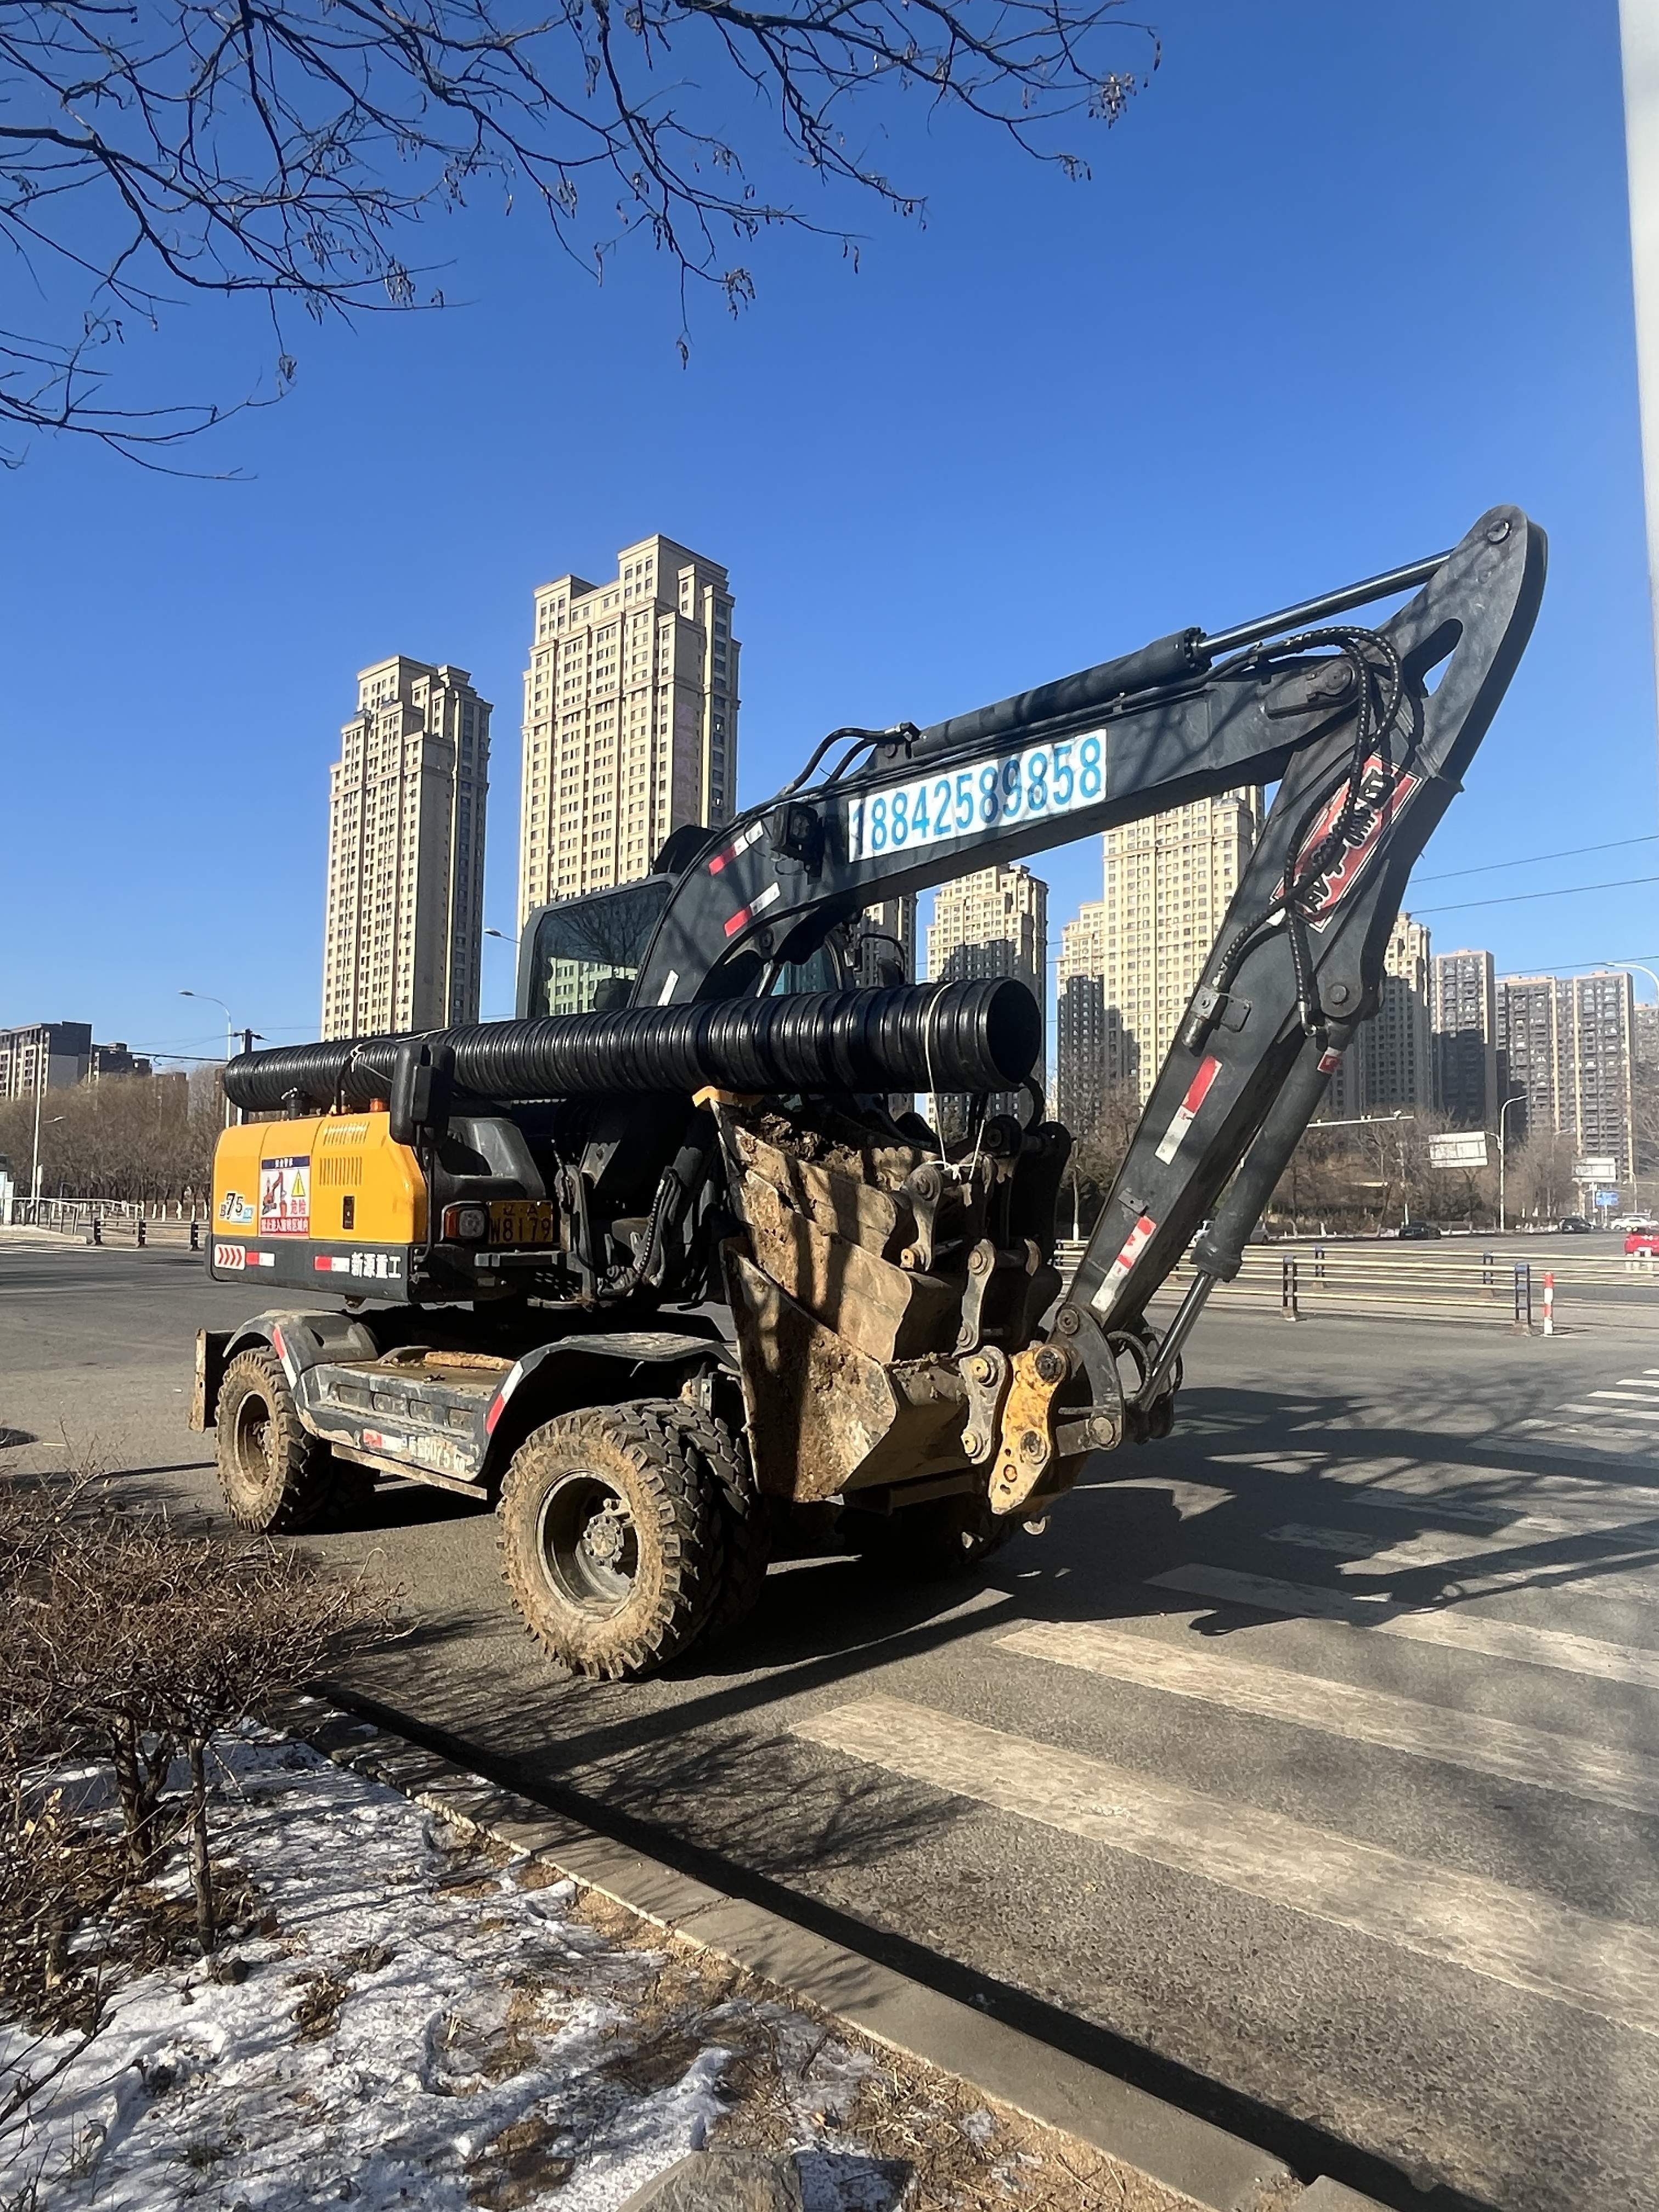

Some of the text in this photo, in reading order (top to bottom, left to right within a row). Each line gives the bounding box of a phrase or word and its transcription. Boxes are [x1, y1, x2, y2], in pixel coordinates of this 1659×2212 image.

[853, 736, 1102, 856] 18842589858
[290, 1198, 307, 1215] 危险
[351, 1252, 402, 1279] 新源重工
